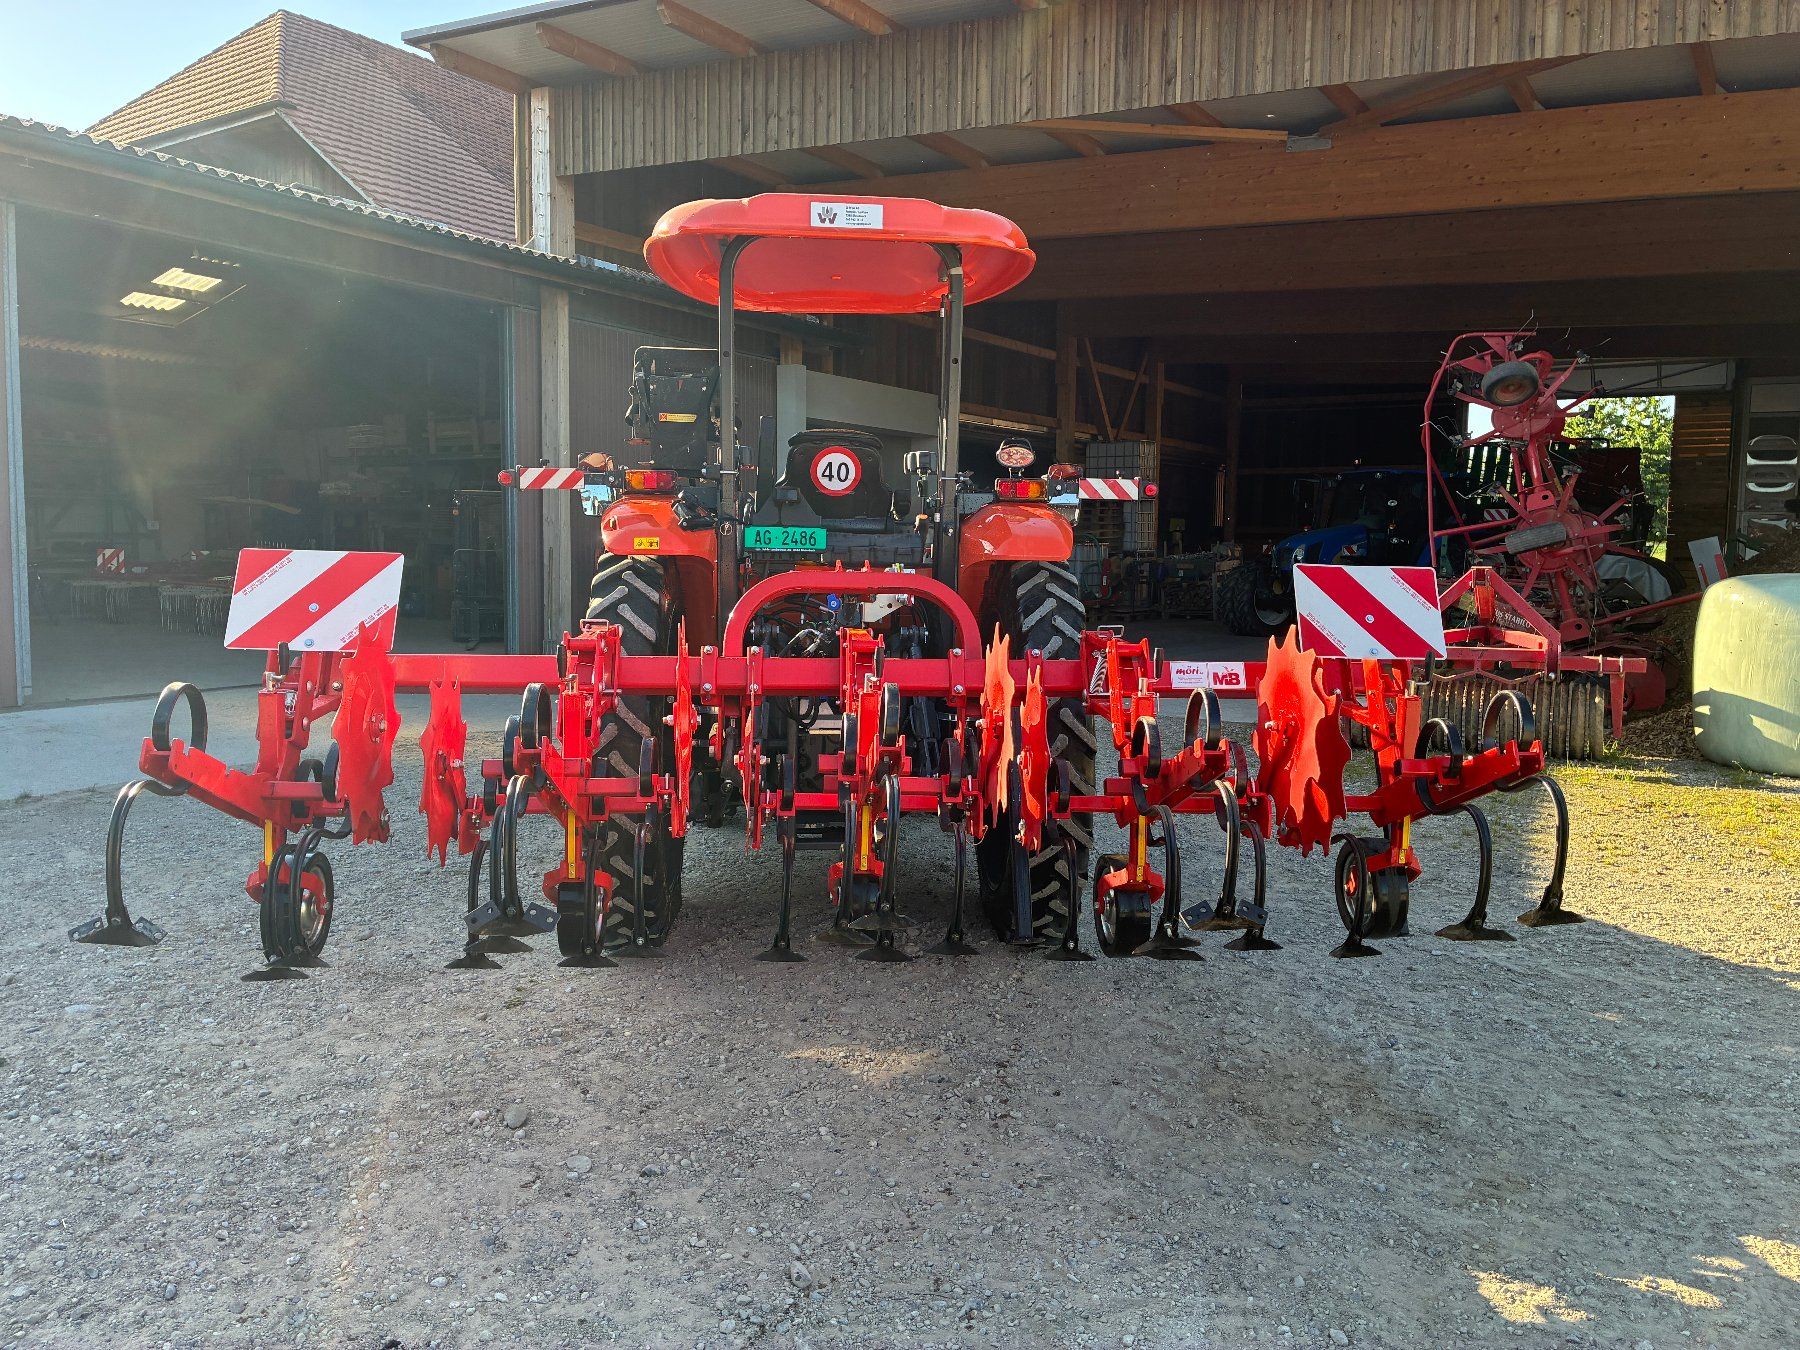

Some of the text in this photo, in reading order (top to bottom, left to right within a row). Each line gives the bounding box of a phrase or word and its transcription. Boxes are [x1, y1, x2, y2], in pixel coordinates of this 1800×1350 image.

[821, 461, 850, 483] 40
[754, 529, 817, 547] AG 2486
